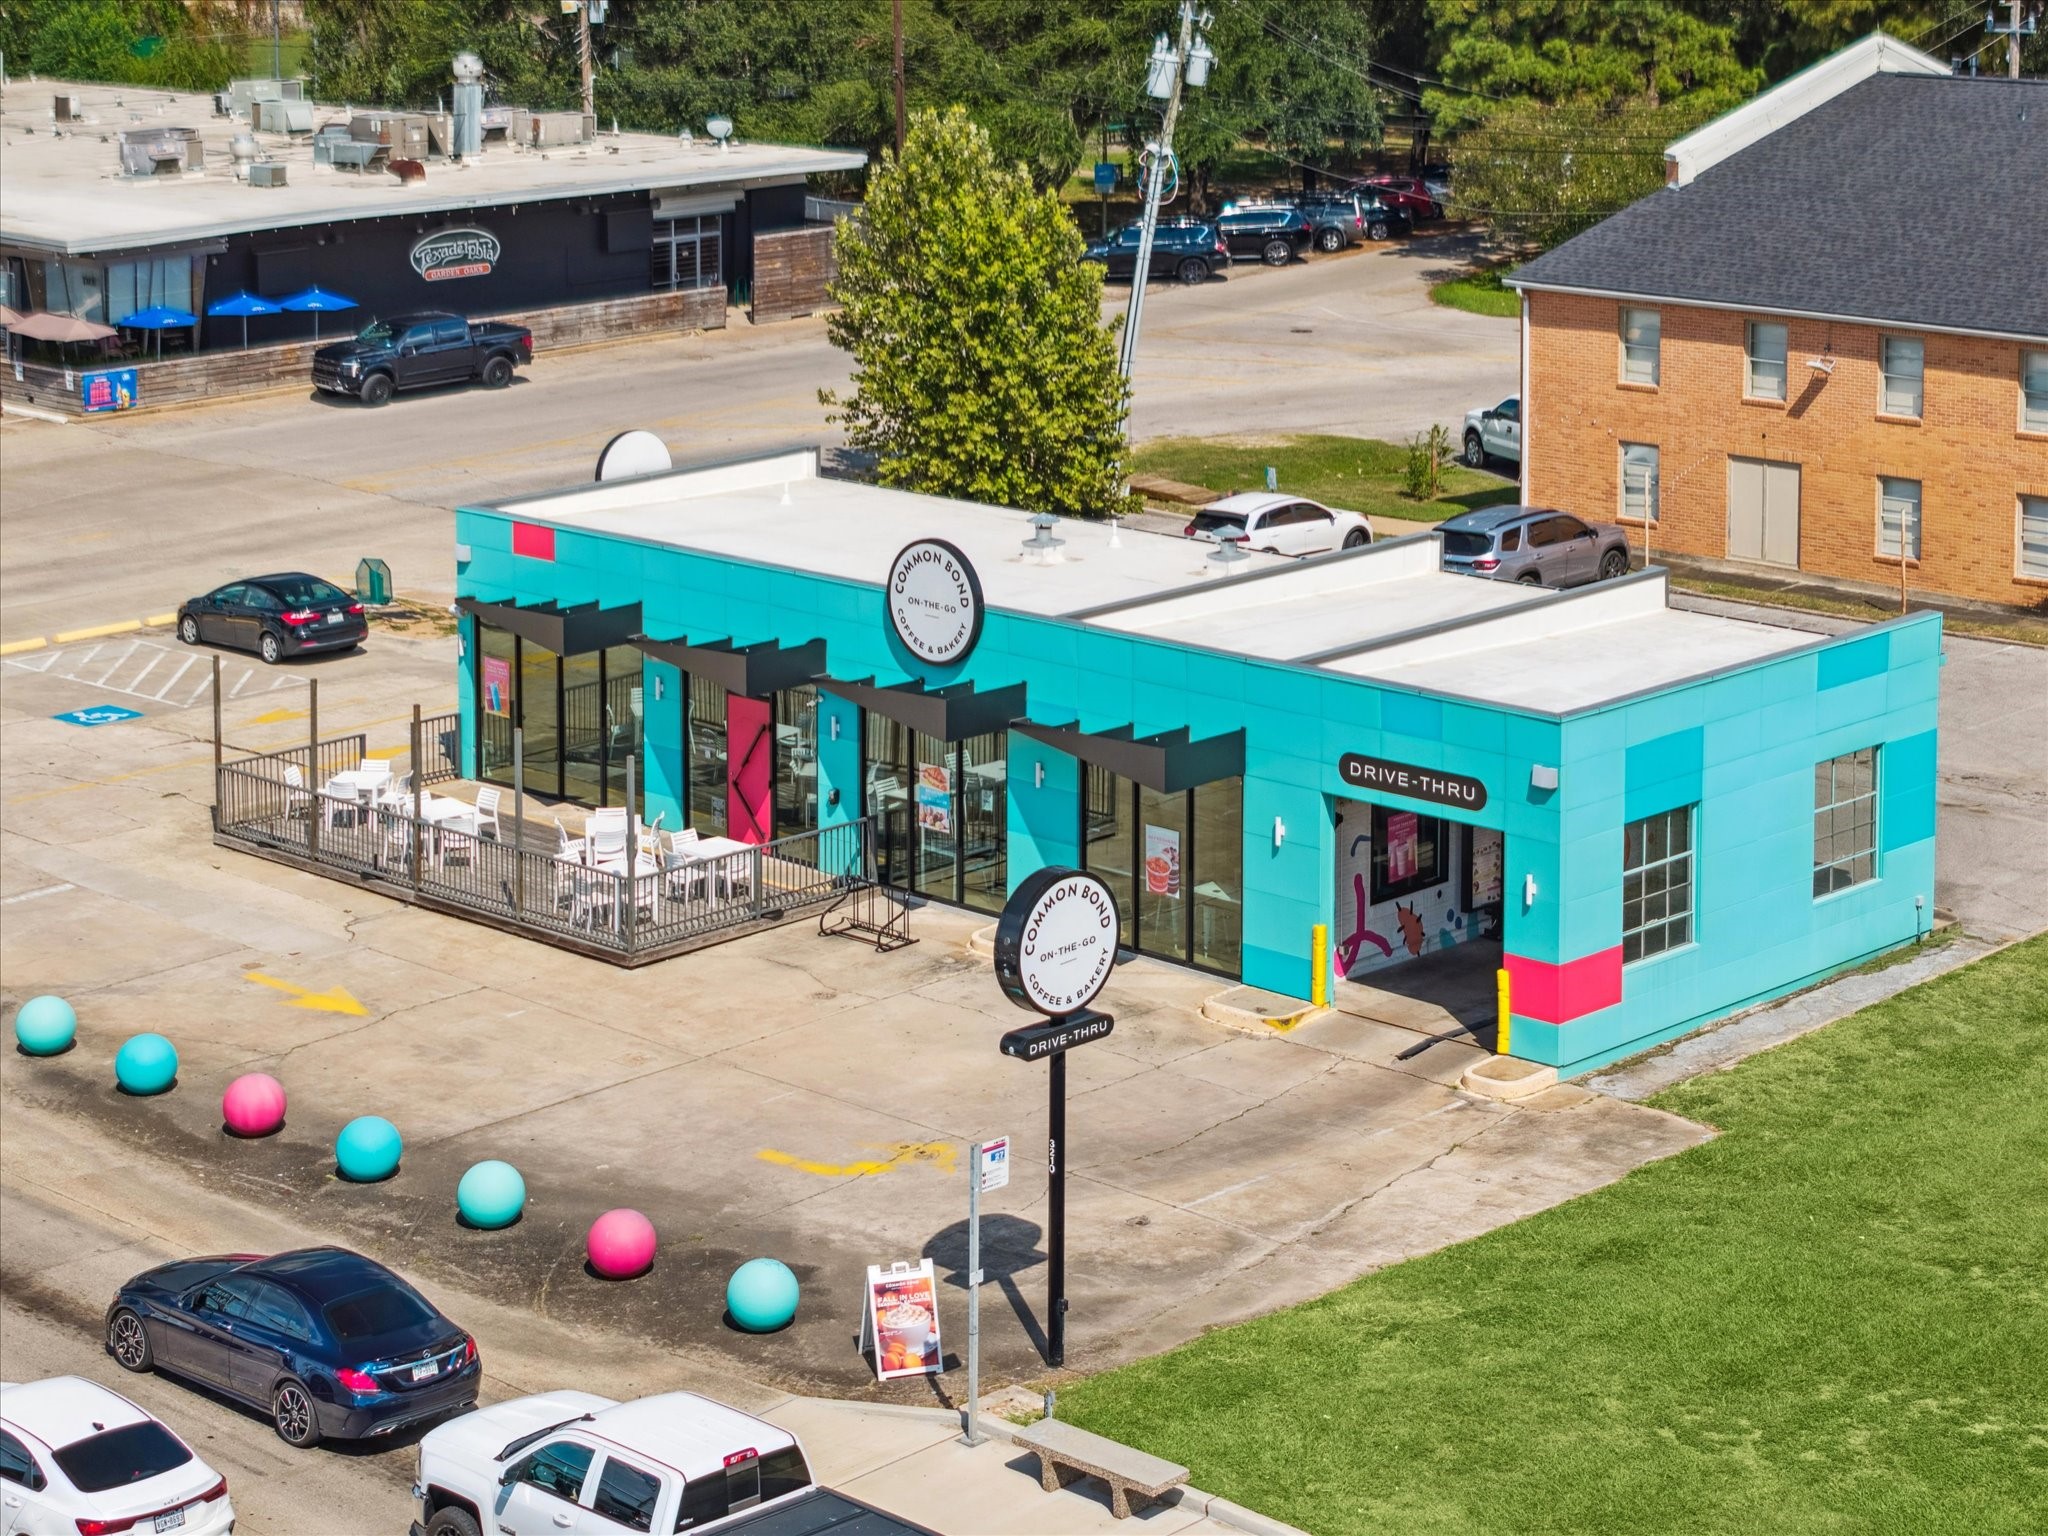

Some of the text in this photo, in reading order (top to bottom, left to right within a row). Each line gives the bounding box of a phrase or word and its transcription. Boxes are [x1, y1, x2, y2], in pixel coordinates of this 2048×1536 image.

[415, 239, 496, 268] Texadelphia
[895, 551, 969, 608] COMMON BOND
[908, 596, 957, 614] ON-THE-GO
[897, 608, 967, 654] COFFEE & BAKERY
[1350, 762, 1475, 801] DRIVE-THRU
[1024, 883, 1111, 956] COMMON BOND
[1040, 935, 1097, 962] ON-THE-GO
[1029, 947, 1109, 1006] COFFEE & BAKERY
[1029, 1020, 1108, 1055] DRIVE-THRU
